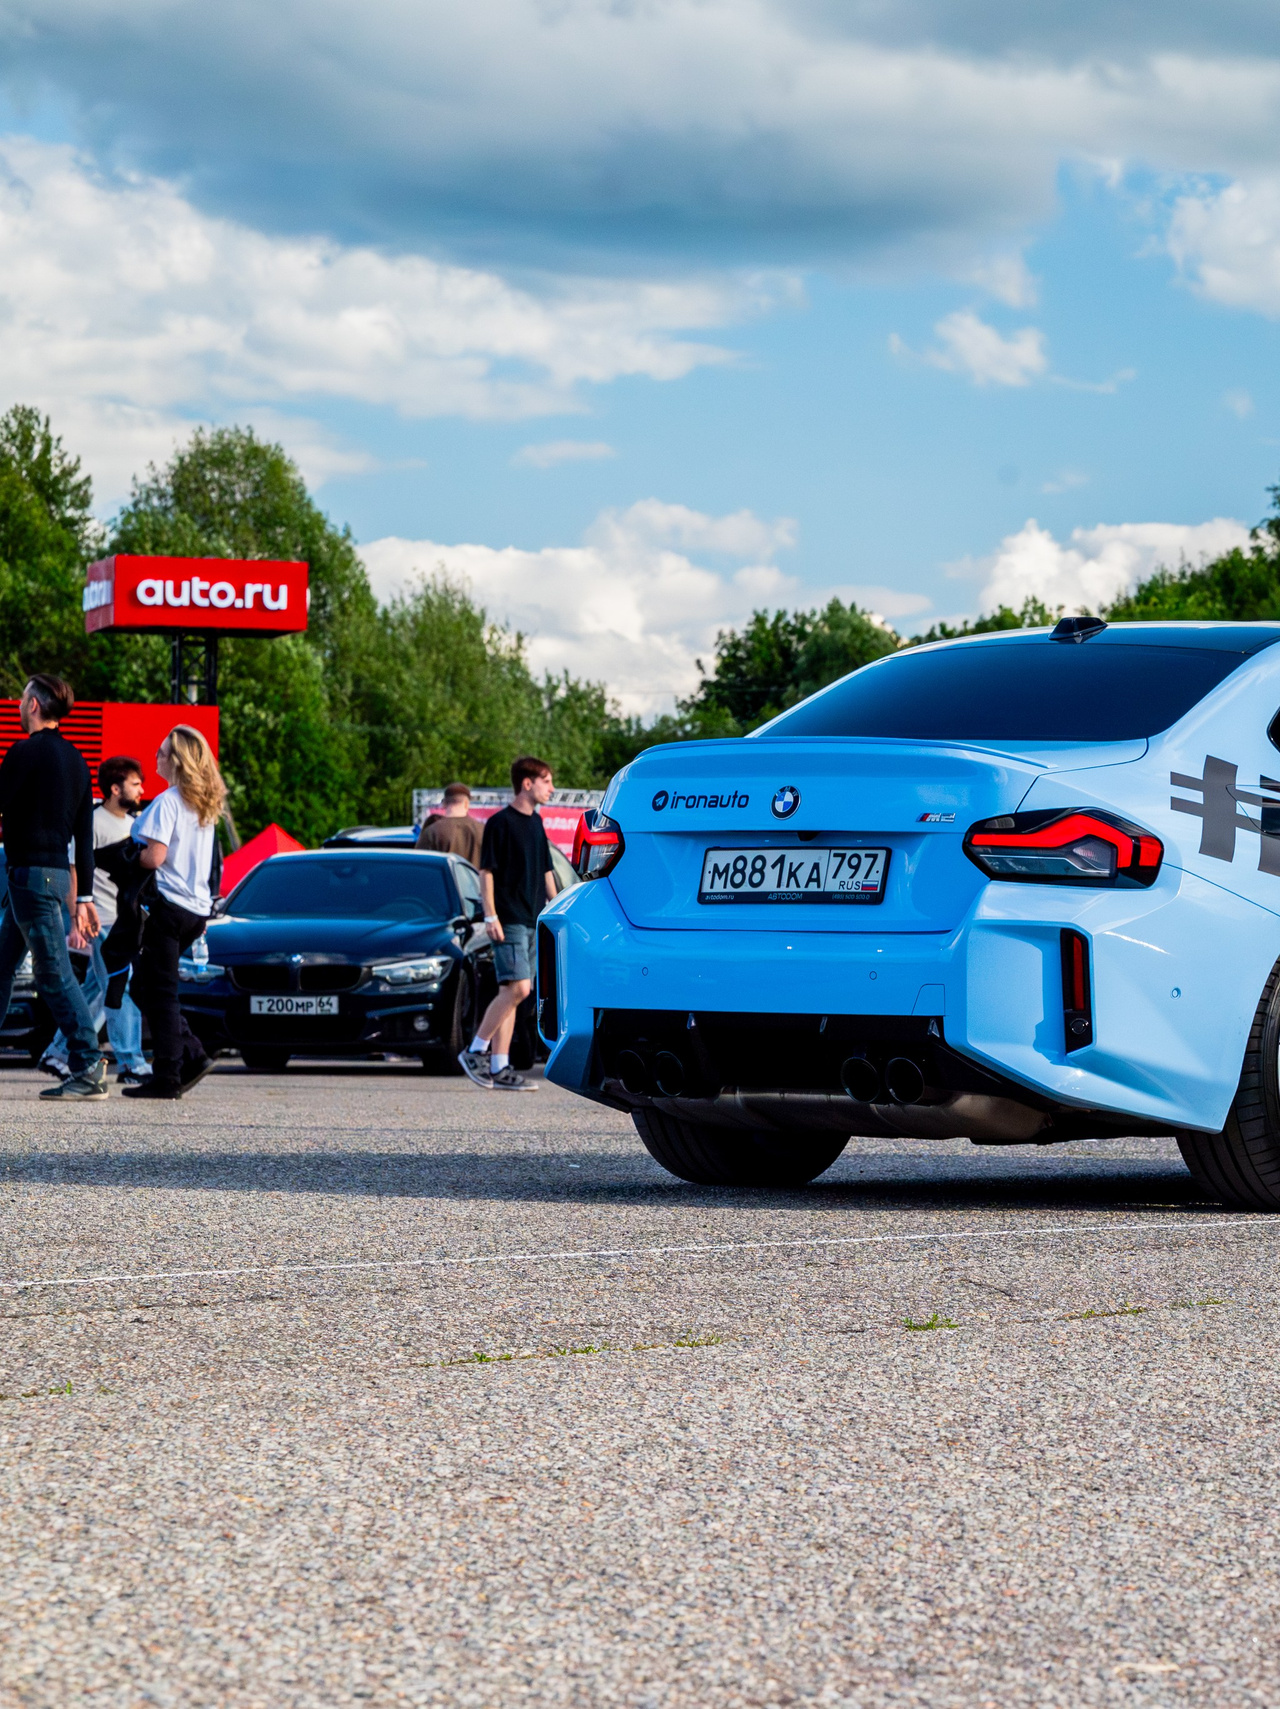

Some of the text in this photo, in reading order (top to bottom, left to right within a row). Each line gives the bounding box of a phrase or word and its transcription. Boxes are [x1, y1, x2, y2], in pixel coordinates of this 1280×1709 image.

[136, 576, 288, 611] auto.ru
[670, 790, 750, 809] ironauto
[831, 852, 879, 880] 797
[838, 880, 861, 891] RUS
